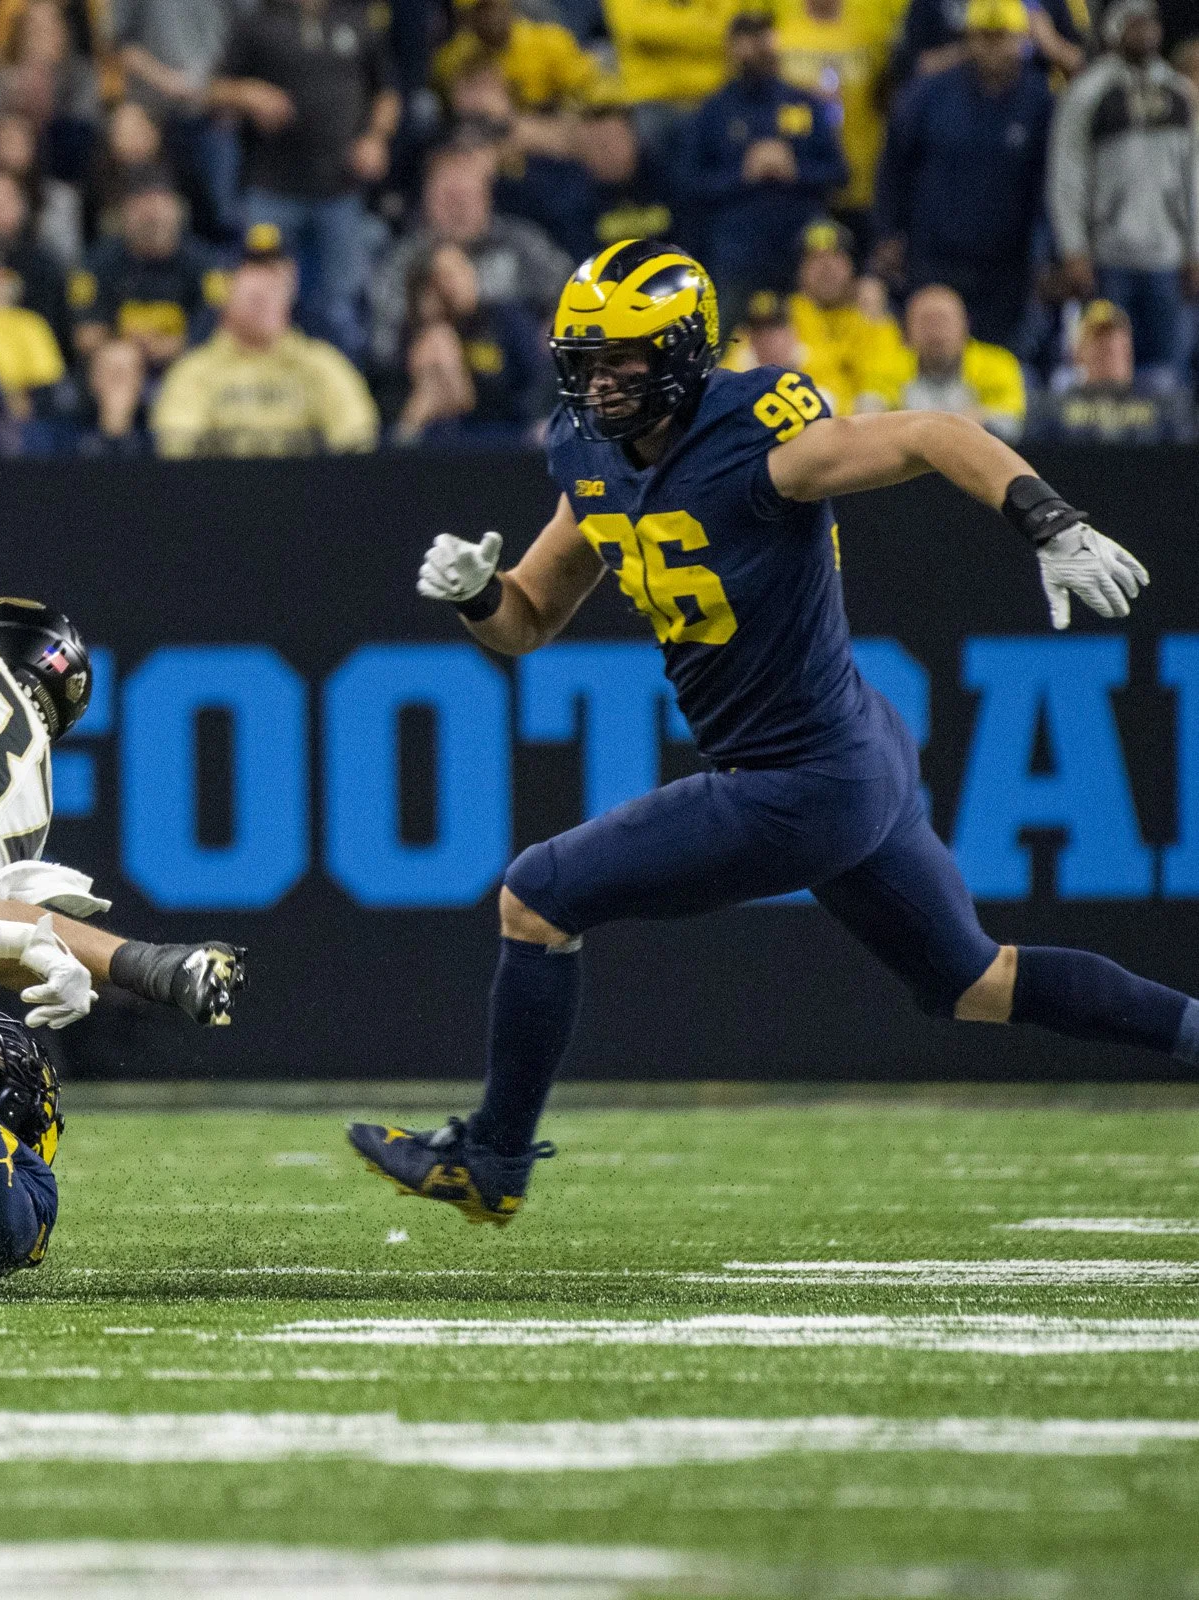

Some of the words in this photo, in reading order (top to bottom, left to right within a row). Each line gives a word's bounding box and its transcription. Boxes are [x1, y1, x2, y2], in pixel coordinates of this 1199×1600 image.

[753, 372, 822, 443] 96
[578, 510, 738, 645] 96
[44, 634, 1199, 912] OOTA
